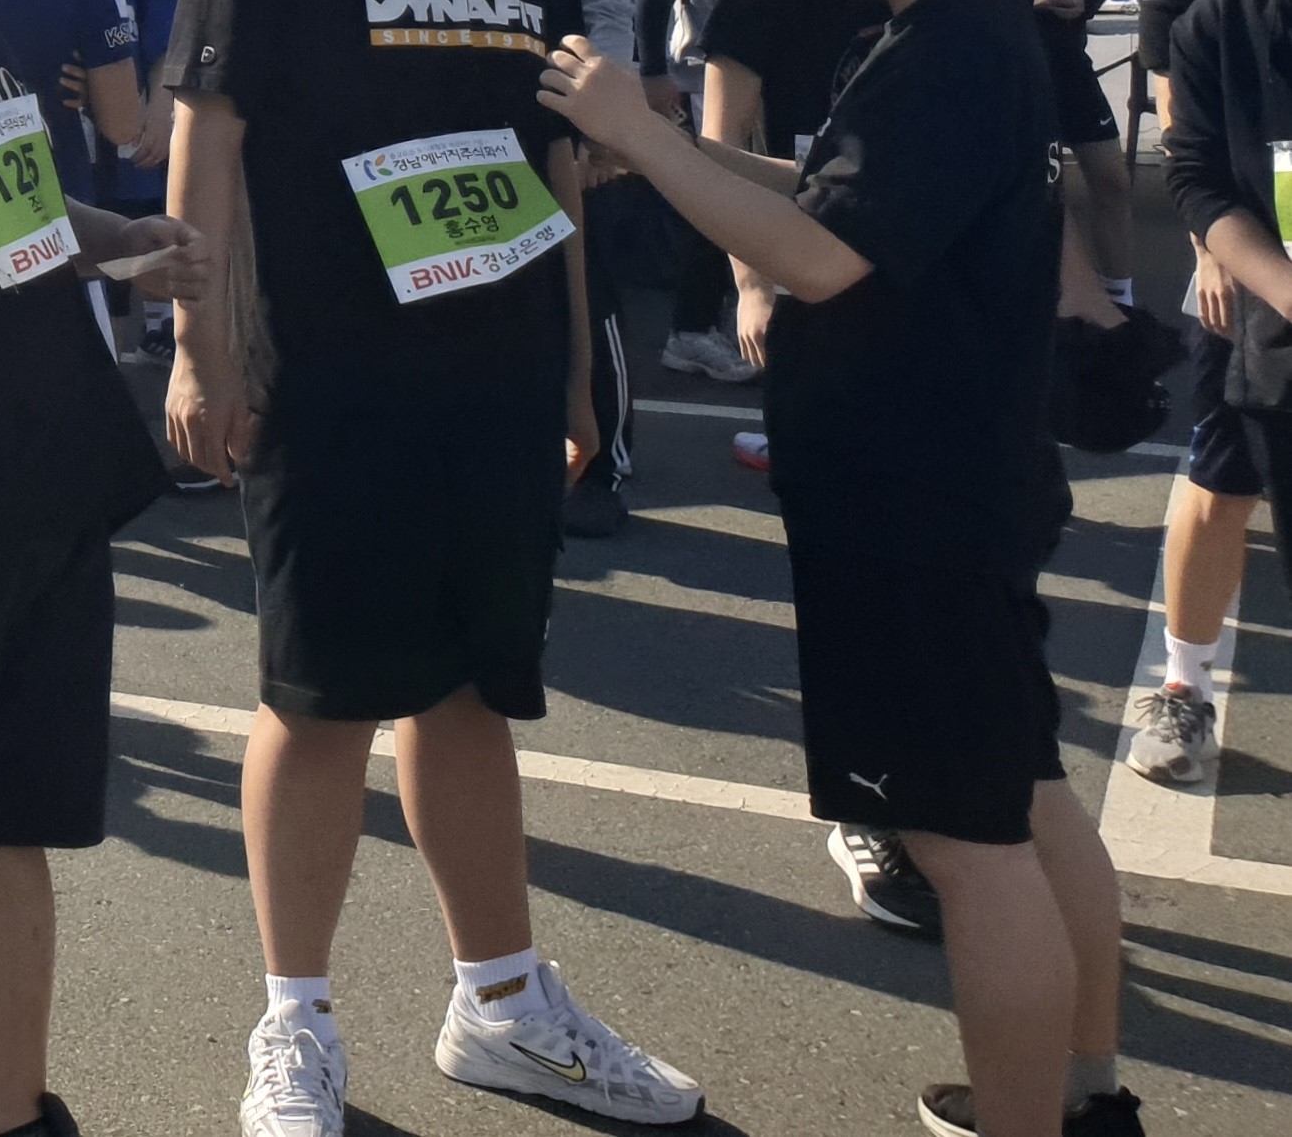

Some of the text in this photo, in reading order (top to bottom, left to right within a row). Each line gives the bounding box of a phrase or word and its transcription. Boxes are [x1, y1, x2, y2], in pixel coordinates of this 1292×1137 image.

[382, 29, 472, 45] SINCE
[392, 144, 509, 171] 경남에너지주식회사
[390, 170, 519, 226] 1250
[443, 214, 500, 239] 홍수영
[409, 224, 556, 291] BNK 경남은행
